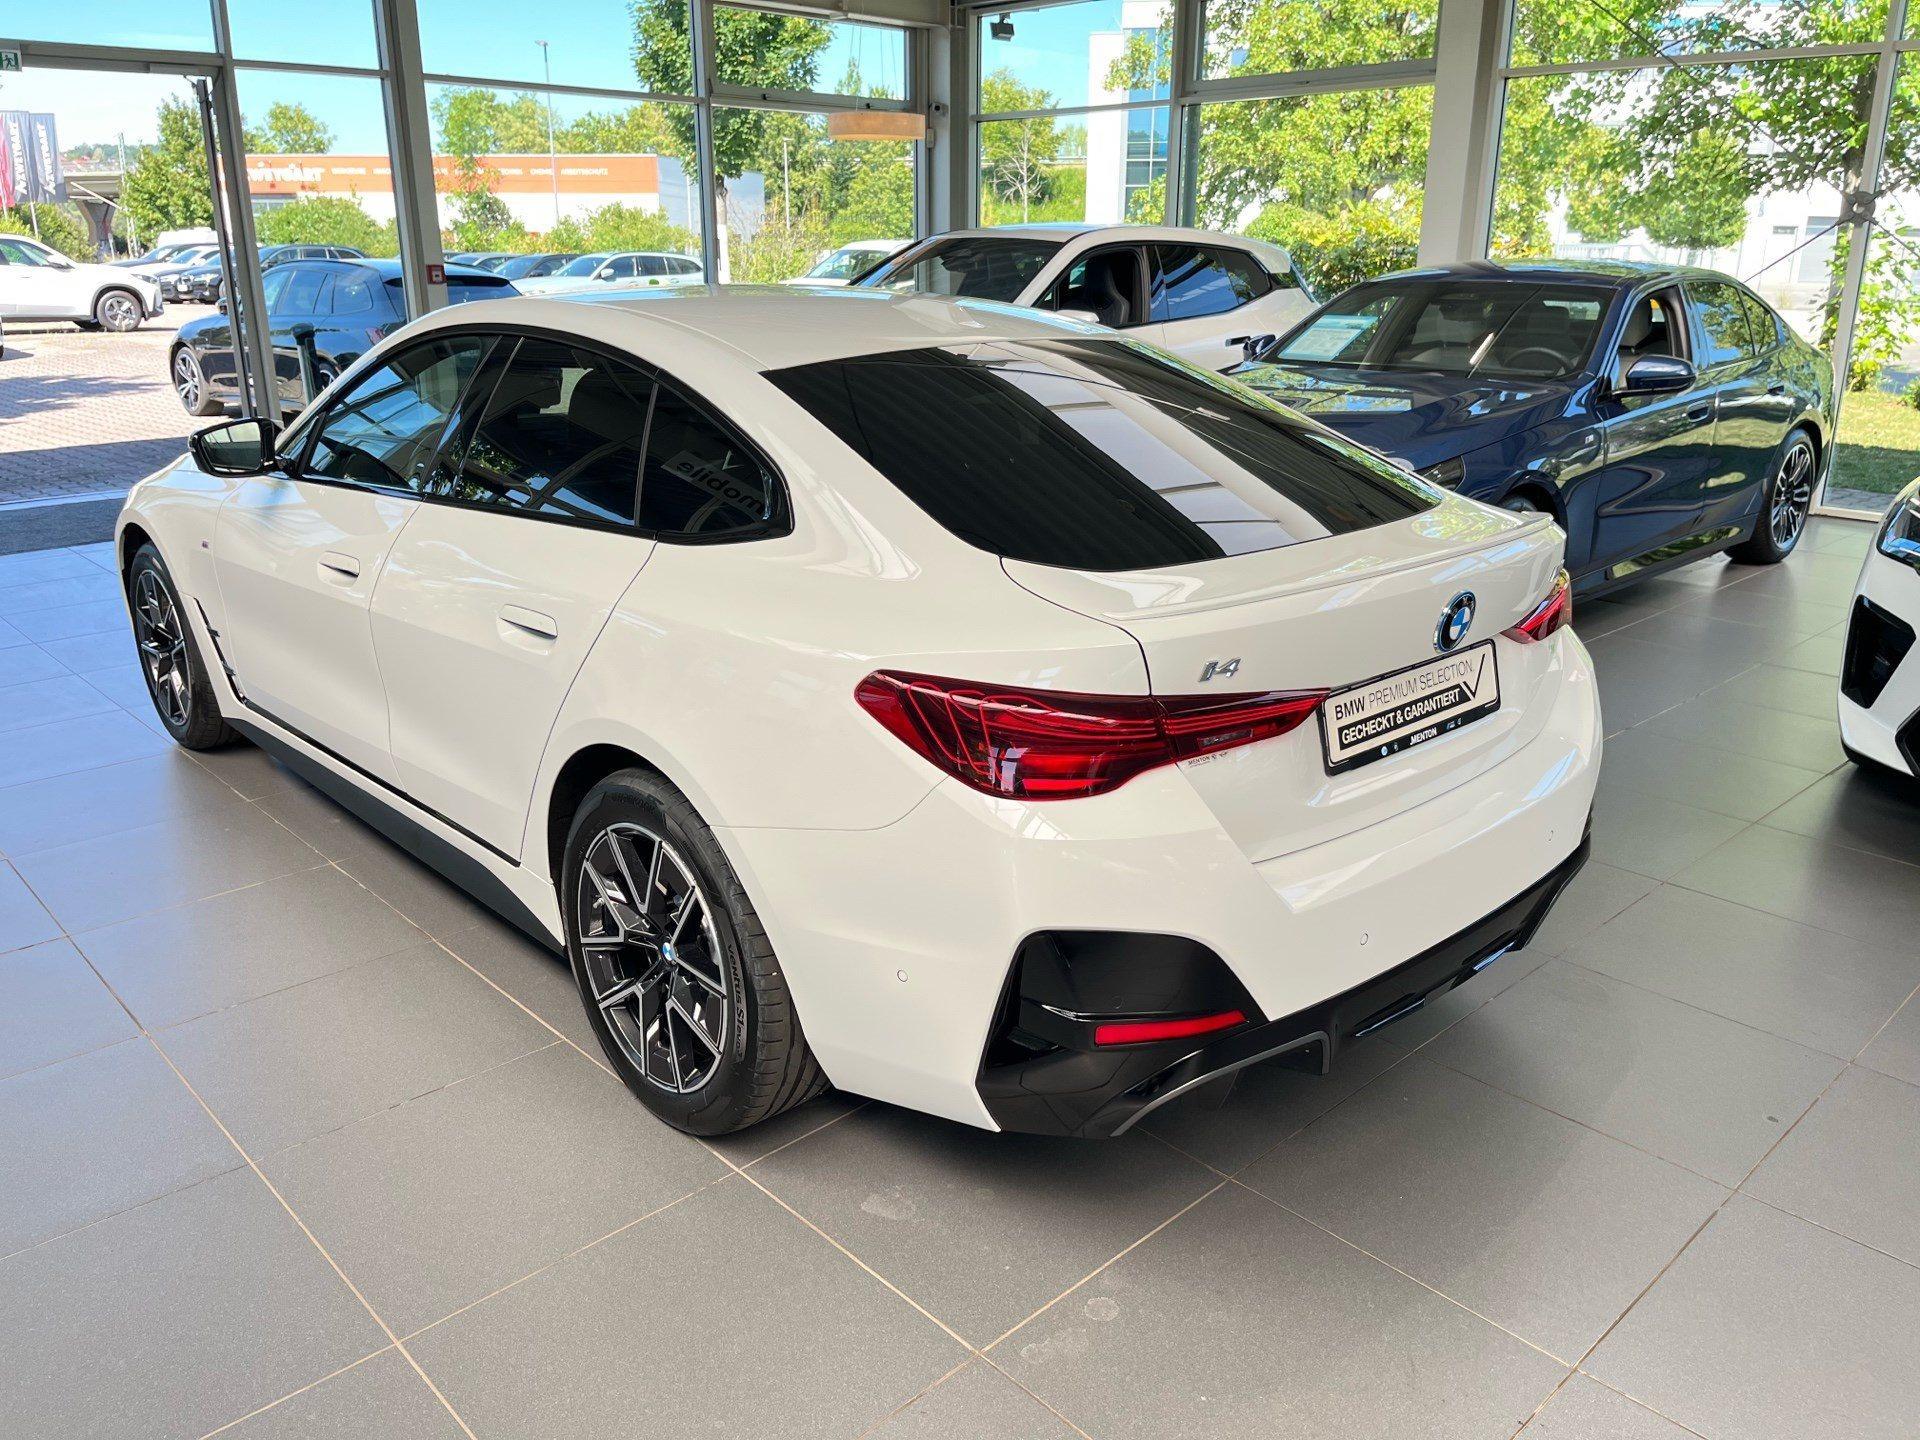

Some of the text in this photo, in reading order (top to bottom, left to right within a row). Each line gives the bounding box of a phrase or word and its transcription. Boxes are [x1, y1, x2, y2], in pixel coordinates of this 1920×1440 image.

[1334, 659, 1474, 720] BMW PREMIUM SELECTION
[1341, 687, 1461, 745] GECHECKT & GARANTIERT
[1409, 727, 1438, 746] MENTON
